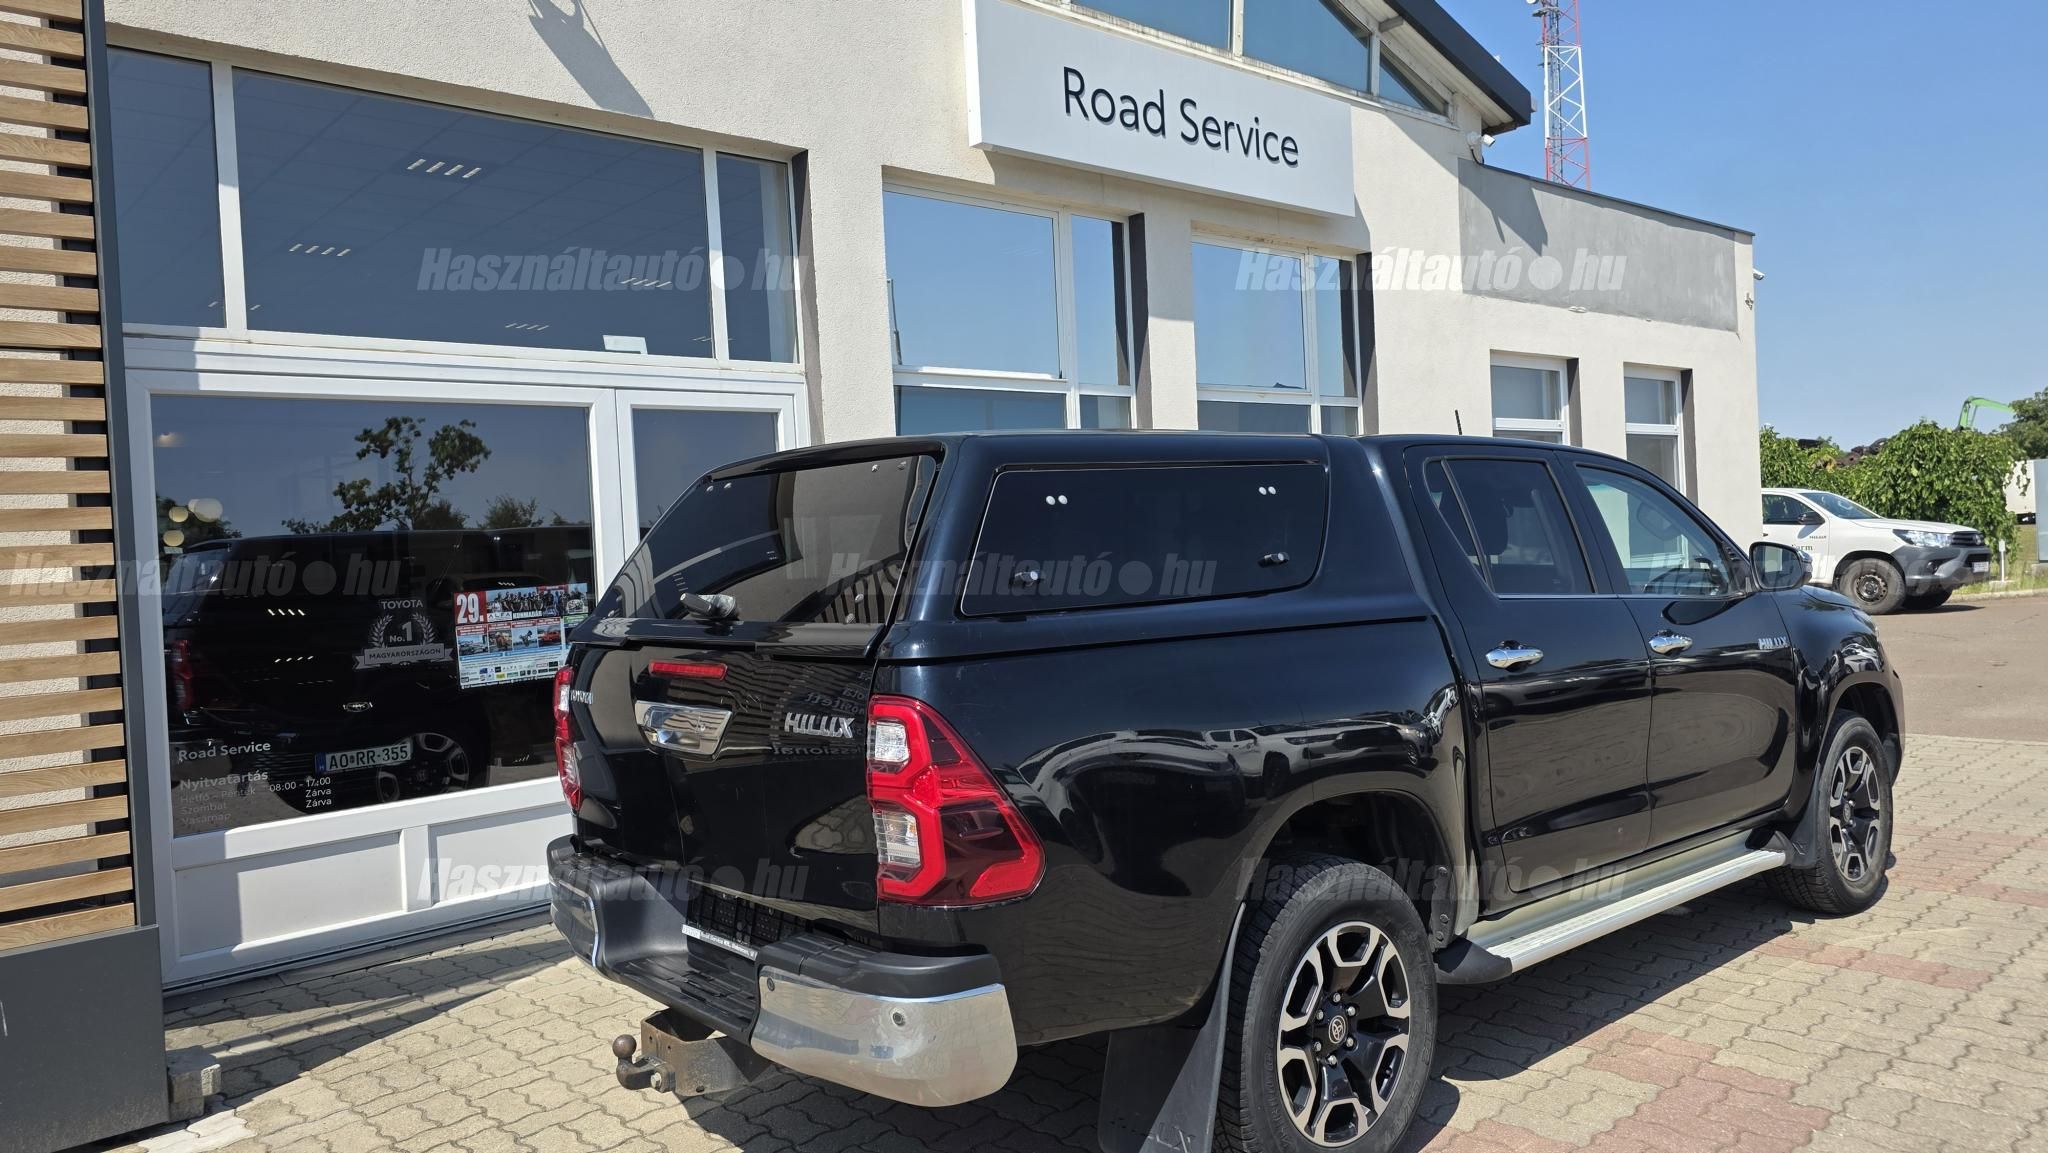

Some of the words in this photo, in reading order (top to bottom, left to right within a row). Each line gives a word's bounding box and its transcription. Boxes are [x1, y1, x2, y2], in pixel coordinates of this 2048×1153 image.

[1063, 66, 1166, 137] Road
[1179, 98, 1299, 167] Service
[380, 599, 424, 610] TOYOTA
[456, 593, 485, 624] 29.
[1758, 636, 1788, 650] HILUX
[784, 711, 856, 739] HILUX
[178, 746, 217, 761] Road
[220, 741, 272, 757] Service
[329, 753, 349, 769] AO
[180, 769, 269, 791] Nyitvatartás
[269, 781, 297, 793] 08:00
[306, 776, 331, 789] 17:00
[305, 787, 332, 799] Zárva
[305, 797, 332, 809] Zárva
